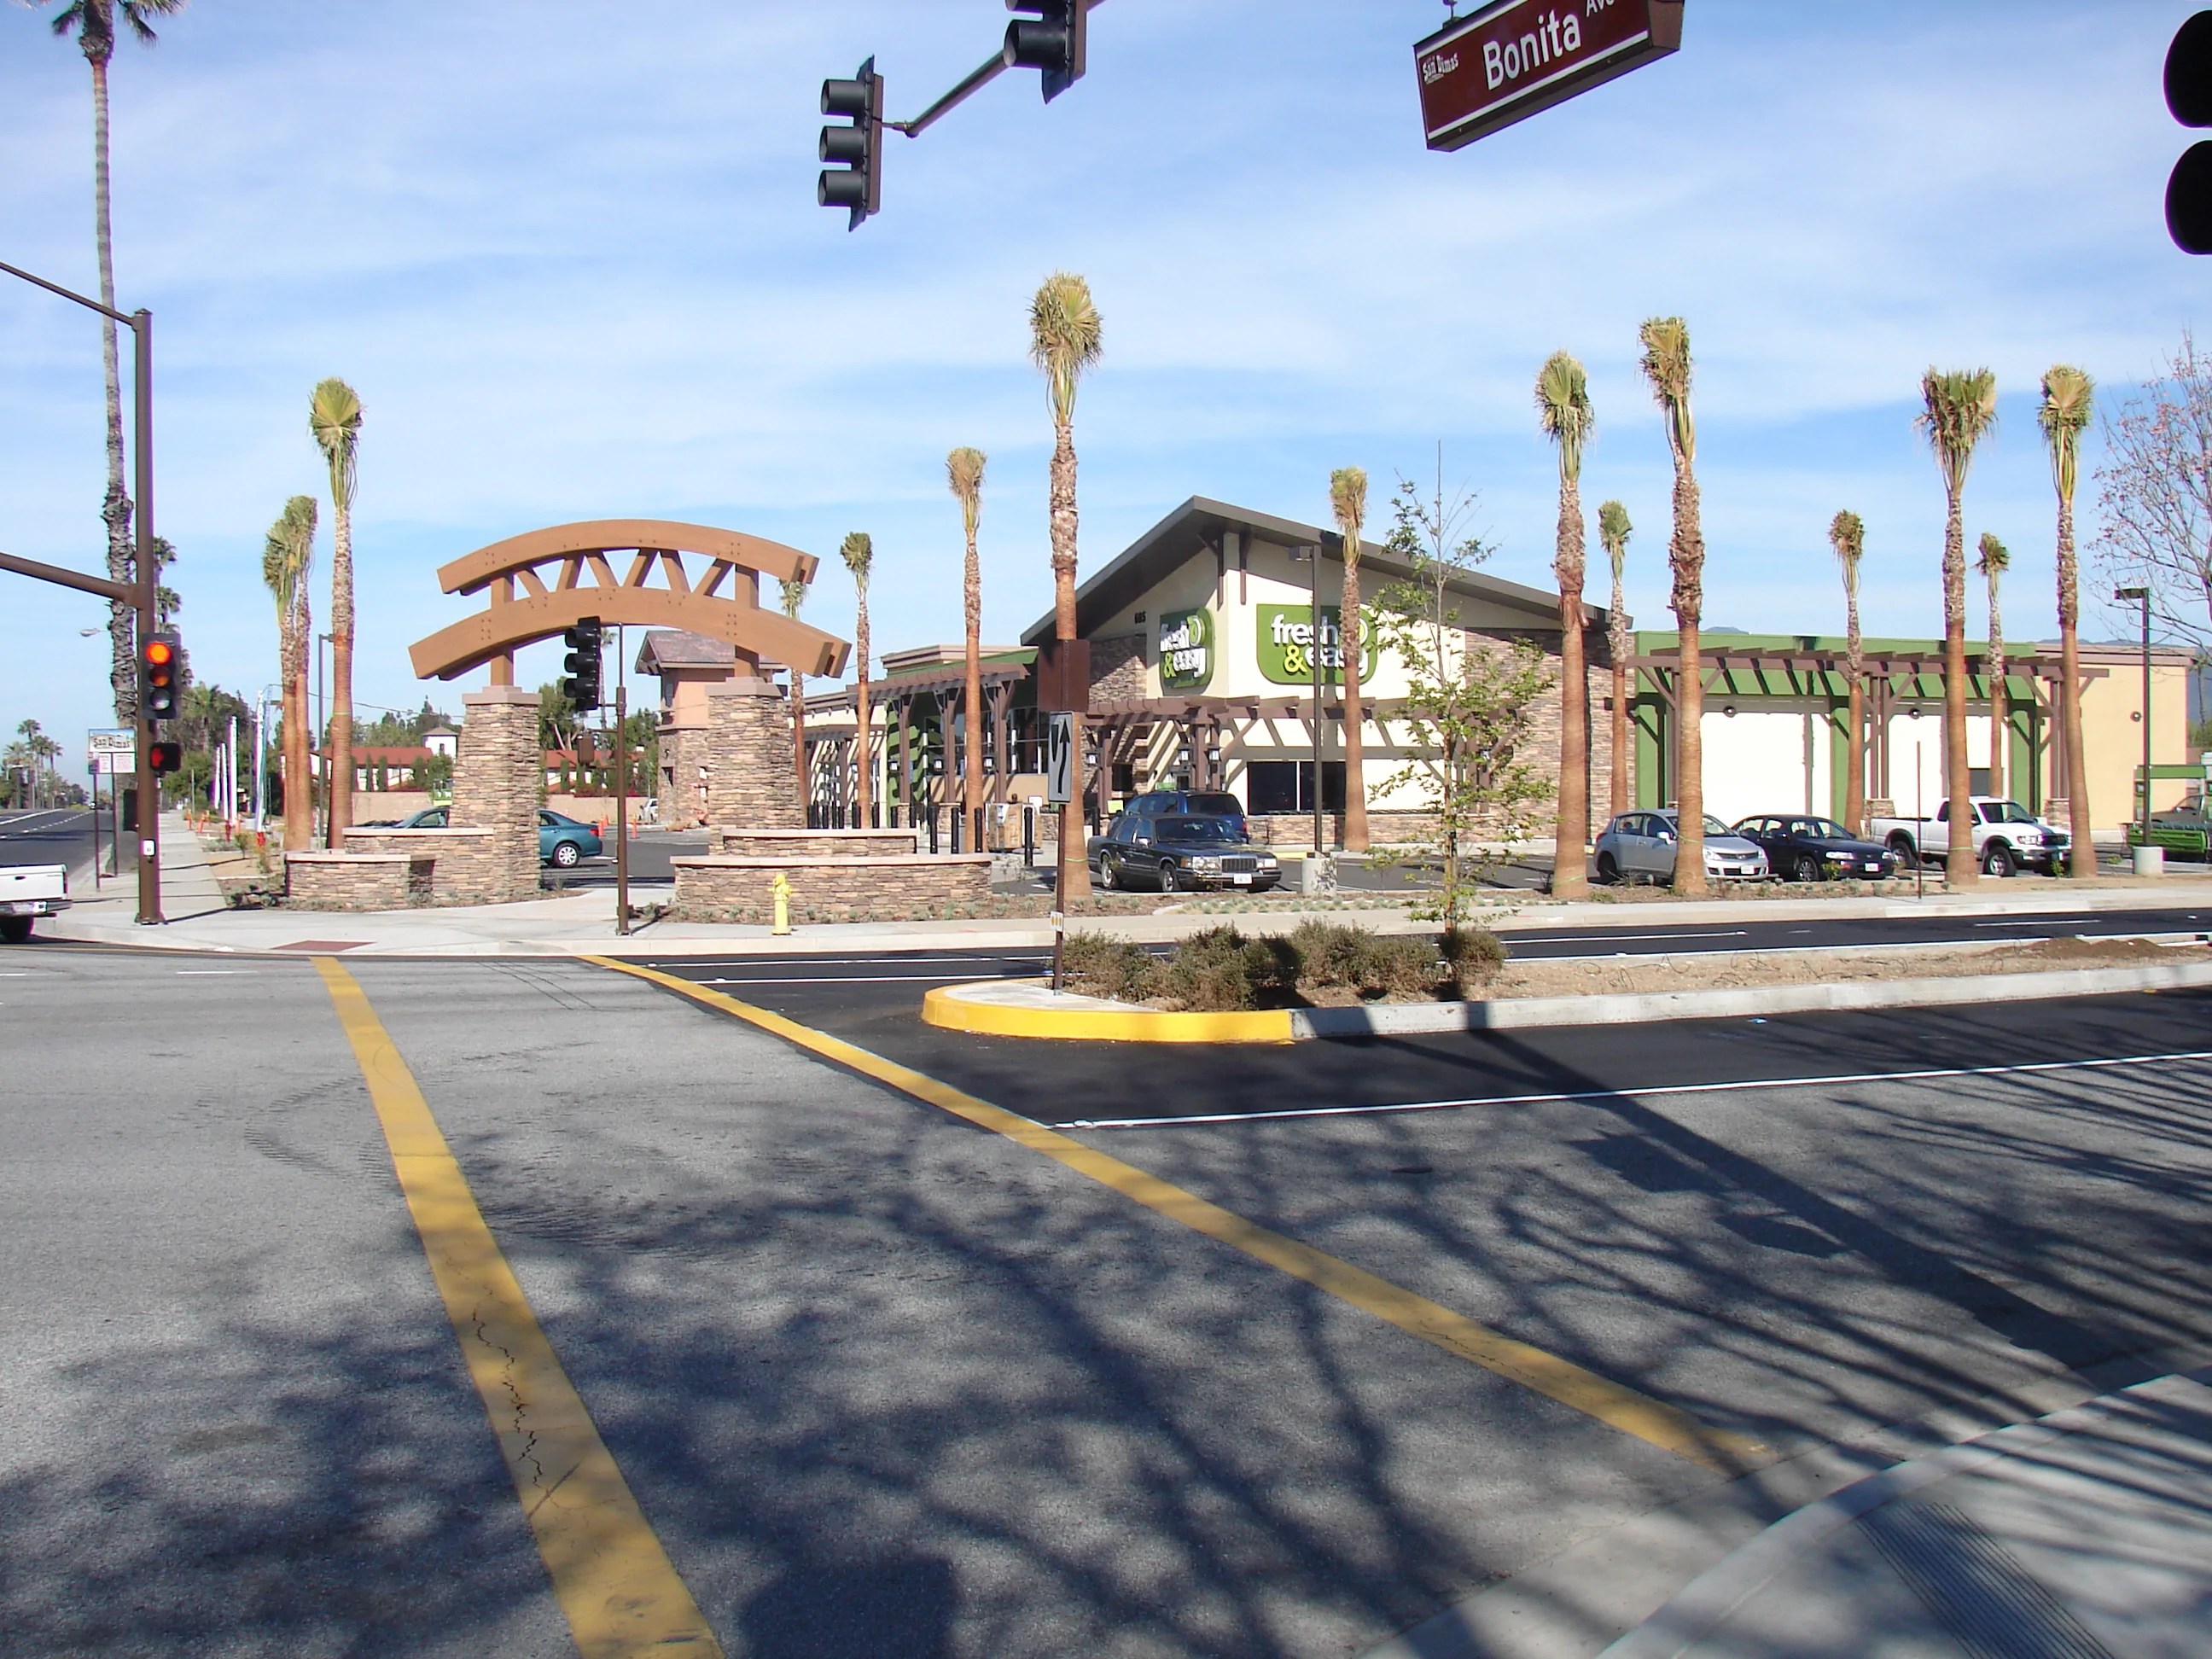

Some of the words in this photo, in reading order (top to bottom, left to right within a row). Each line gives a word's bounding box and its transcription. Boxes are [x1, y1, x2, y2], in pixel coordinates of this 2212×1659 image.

[1482, 9, 1580, 90] Bonita
[1160, 620, 1190, 652] fresh
[1271, 614, 1339, 645] fresh
